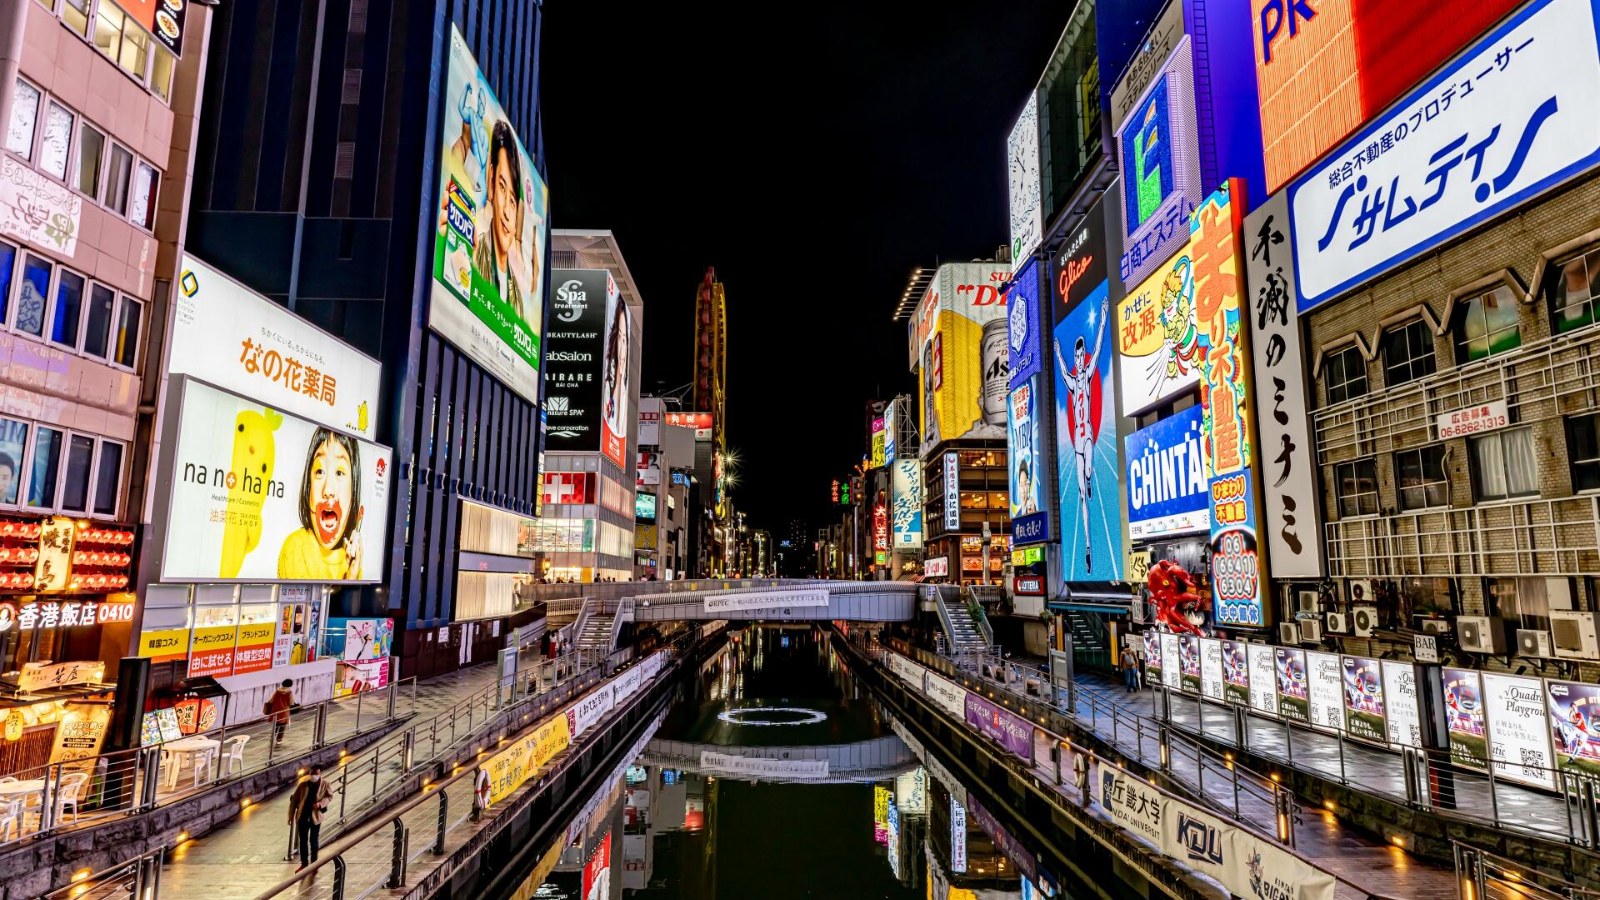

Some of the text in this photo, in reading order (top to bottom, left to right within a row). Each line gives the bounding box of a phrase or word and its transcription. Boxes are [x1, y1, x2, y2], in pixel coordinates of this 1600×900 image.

[1121, 37, 1171, 117] エステムシリーズ
[1328, 37, 1534, 190] 総合不動産のプロデューサー
[1060, 229, 1089, 266] おいしさと健康
[1120, 198, 1194, 282] 日商エステム
[990, 272, 1013, 282] SU
[1059, 255, 1093, 303] Glico
[557, 287, 587, 304] Spa
[1124, 291, 1151, 322] かぜに
[1122, 304, 1156, 352] 改源
[239, 337, 337, 407] なの花薬局
[1077, 391, 1085, 438] グリコ
[1451, 406, 1490, 424] 広告募集
[1440, 416, 1505, 438] 06-6262-1313
[1213, 477, 1246, 500] ひまわり
[1215, 502, 1246, 525] 不動産
[1225, 534, 1241, 554] 06
[1215, 556, 1256, 578] (6641)
[1219, 577, 1252, 598] 6304
[17, 602, 133, 630] 香港飯店 0410
[1219, 603, 1259, 624] 年中無休
[149, 638, 179, 649] 韓国コスメ
[193, 632, 235, 645] オーガニックコスメ
[242, 629, 270, 639] ブランドコスメ
[1415, 636, 1436, 650] BAR
[236, 647, 272, 663] 体験型空間
[1176, 811, 1223, 866] KDU
